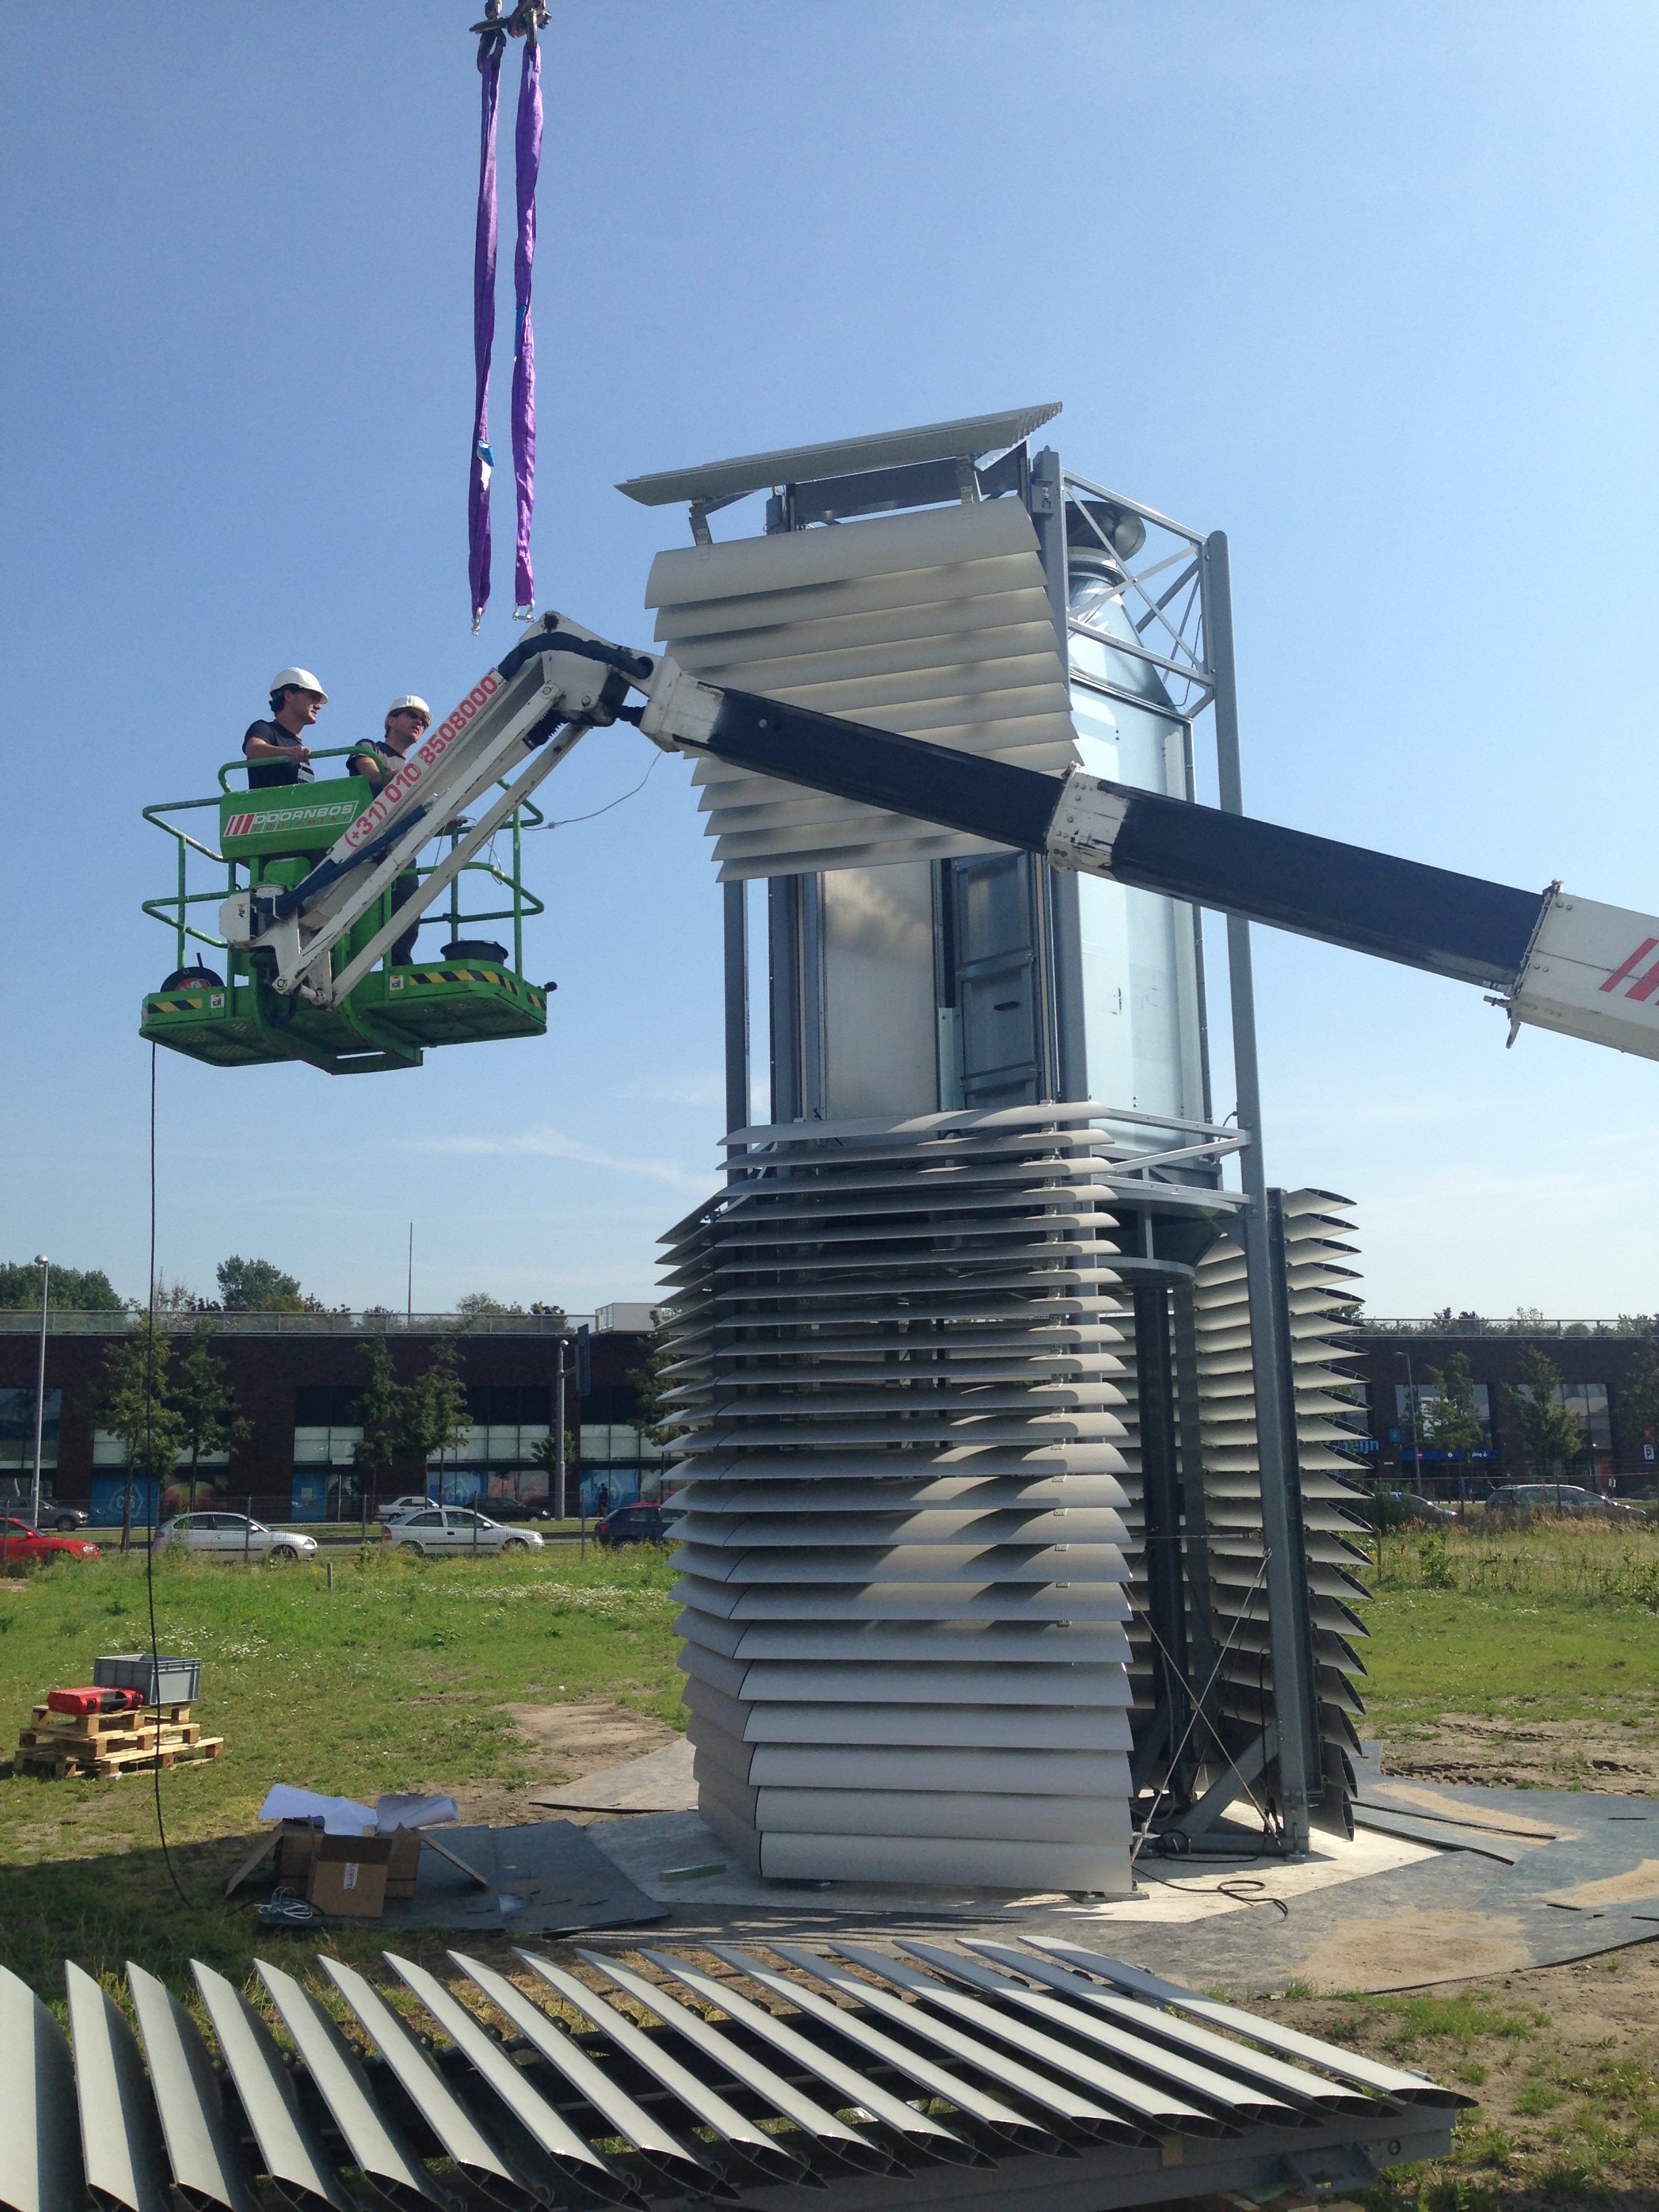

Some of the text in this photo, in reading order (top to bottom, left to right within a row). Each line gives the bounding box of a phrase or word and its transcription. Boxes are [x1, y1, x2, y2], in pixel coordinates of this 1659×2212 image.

[344, 676, 498, 847] (+31) 010 8508000
[253, 804, 353, 824] DOORNBOS
[253, 815, 348, 832] EQUIPMENT
